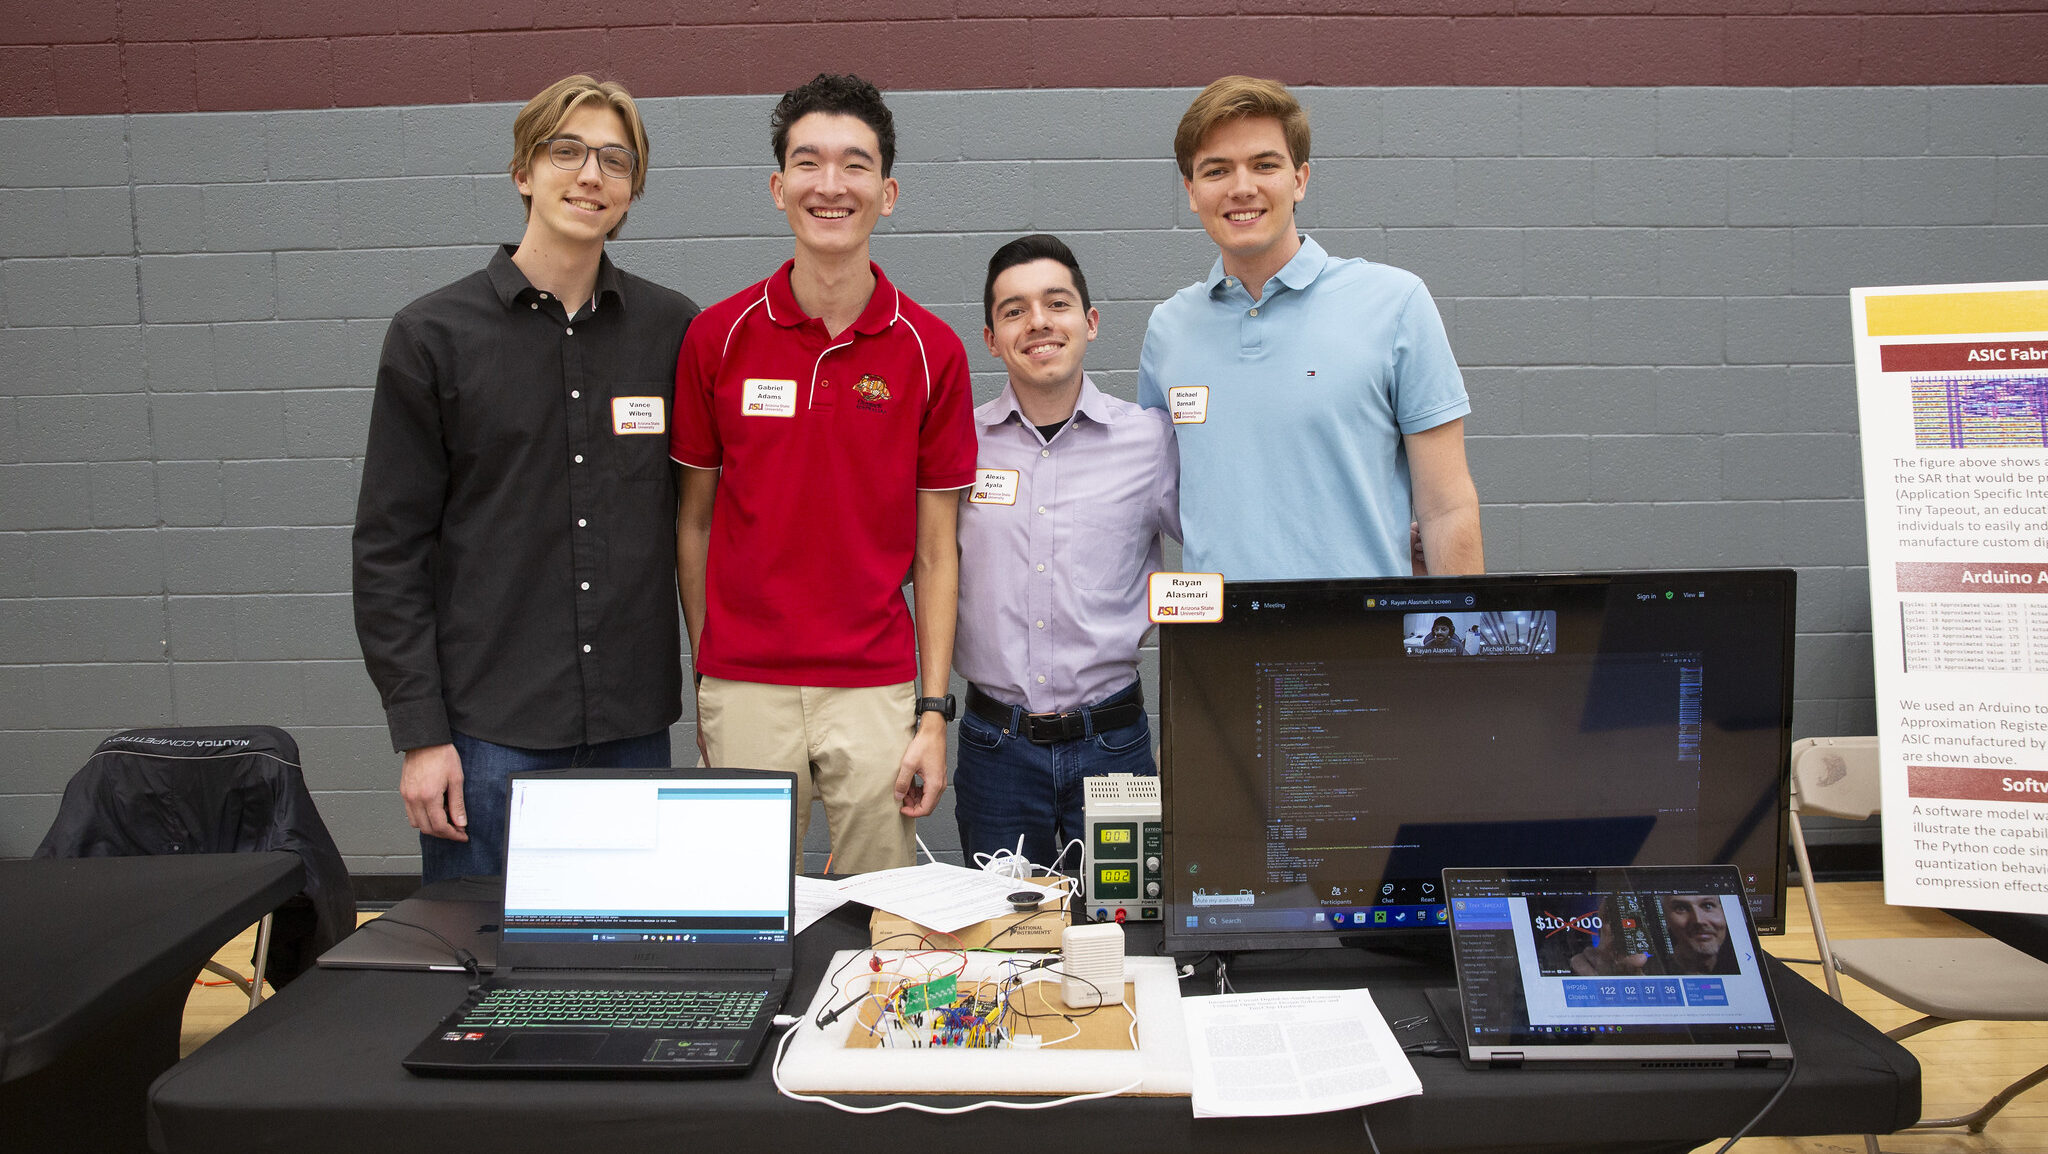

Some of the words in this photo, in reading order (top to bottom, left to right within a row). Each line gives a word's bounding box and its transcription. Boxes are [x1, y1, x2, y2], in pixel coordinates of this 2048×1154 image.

[1968, 349, 2006, 362] ASIC
[1894, 458, 1916, 467] The
[1920, 458, 1955, 471] figure
[1959, 457, 1997, 467] above
[2001, 457, 2041, 467] shows
[1895, 474, 1915, 483] the
[1919, 474, 1942, 483] SAR
[1946, 473, 1971, 483] that
[1975, 473, 2013, 483] would
[2018, 473, 2034, 483] be
[1896, 489, 1970, 501] (Application
[1974, 489, 2022, 501] Specific
[1897, 505, 1921, 516] Tiny
[1927, 505, 1980, 517] Tapeout,
[1984, 506, 2000, 515] an
[1898, 521, 1964, 531] individuals
[1968, 522, 1981, 531] to
[1985, 521, 2020, 534] easily
[1899, 537, 1979, 547] manufacture
[1983, 538, 2030, 548] custom
[1172, 579, 1202, 587] Rayan
[1961, 570, 2033, 584] Arduino
[1166, 591, 1208, 599] Alasmari
[1637, 593, 1650, 601] Sign
[1157, 606, 1178, 616] ASU
[1900, 700, 1921, 710] We
[1925, 701, 1955, 712] used
[1959, 704, 1974, 712] an
[1979, 702, 2031, 714] Arduino
[2035, 704, 2048, 714] to
[1901, 717, 1996, 730] Approximation
[196, 739, 250, 747] NAUTICA
[1902, 734, 1930, 745] ASIC
[1934, 735, 2026, 748] manufactured
[2031, 737, 2045, 751] by
[1903, 753, 1923, 761] are
[1927, 752, 1969, 763] shown
[1974, 753, 2017, 765] above.
[1913, 805, 1922, 816] A
[1925, 806, 1983, 818] software
[1987, 809, 2029, 821] model
[1914, 822, 1970, 835] illustrate
[1975, 825, 1996, 836] the
[1914, 840, 1938, 851] The
[1942, 841, 1989, 855] Python
[1994, 844, 2026, 856] code
[1915, 859, 1998, 873] quantization
[1916, 876, 2000, 891] compression
[2004, 880, 2048, 893] effects
[1535, 914, 1603, 933] $10,000
[1600, 987, 1616, 995] 122
[1625, 987, 1636, 995] 02
[1645, 986, 1655, 994] 37
[1664, 986, 1676, 994] 36
